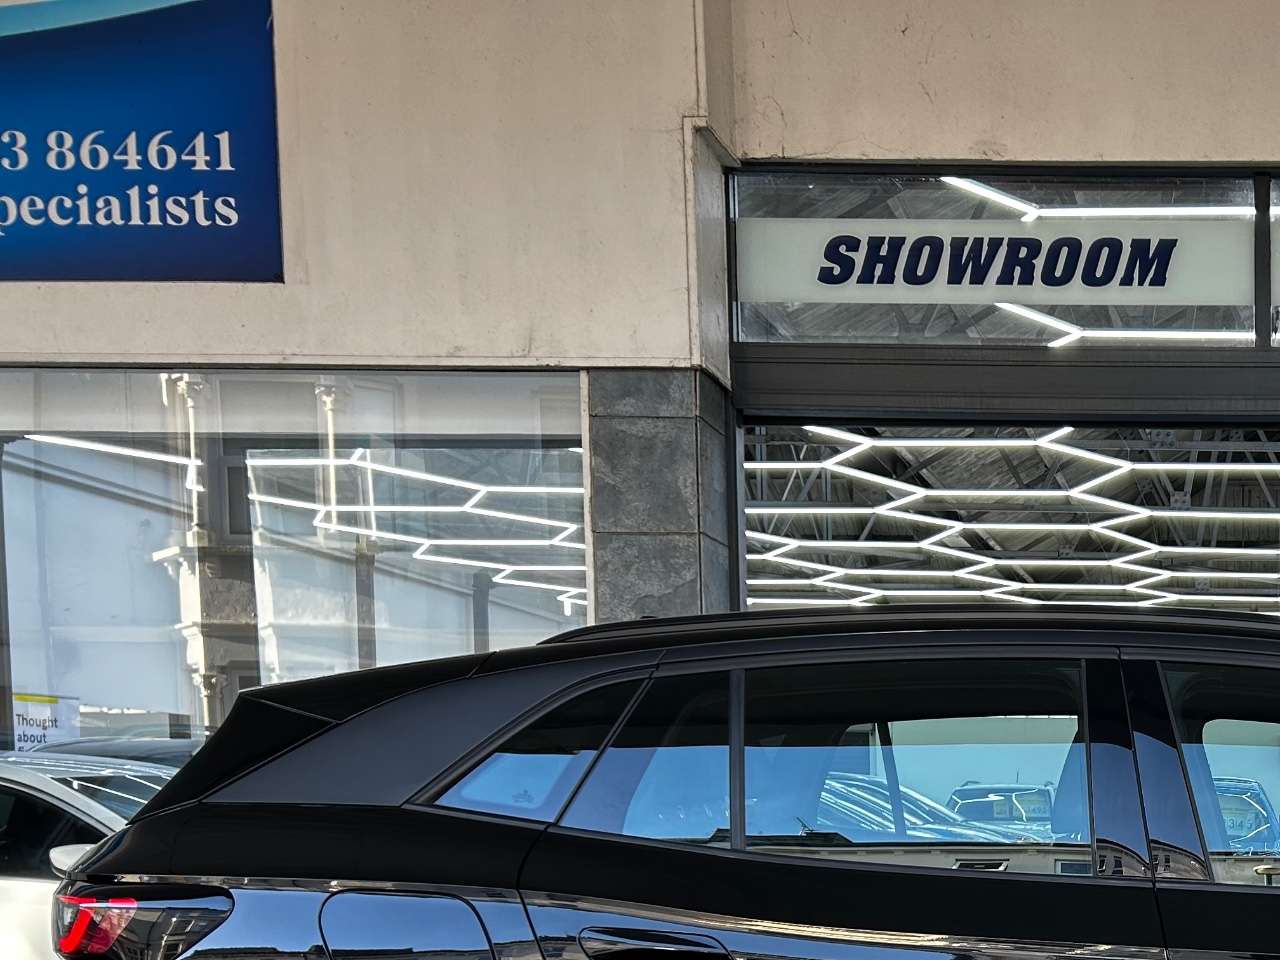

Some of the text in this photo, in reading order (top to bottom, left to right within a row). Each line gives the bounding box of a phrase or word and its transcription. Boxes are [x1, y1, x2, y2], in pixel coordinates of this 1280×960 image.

[1, 130, 236, 171] 3 864641
[816, 235, 1179, 287] SHOWROOM
[16, 713, 58, 730] Thought
[17, 730, 47, 744] about
